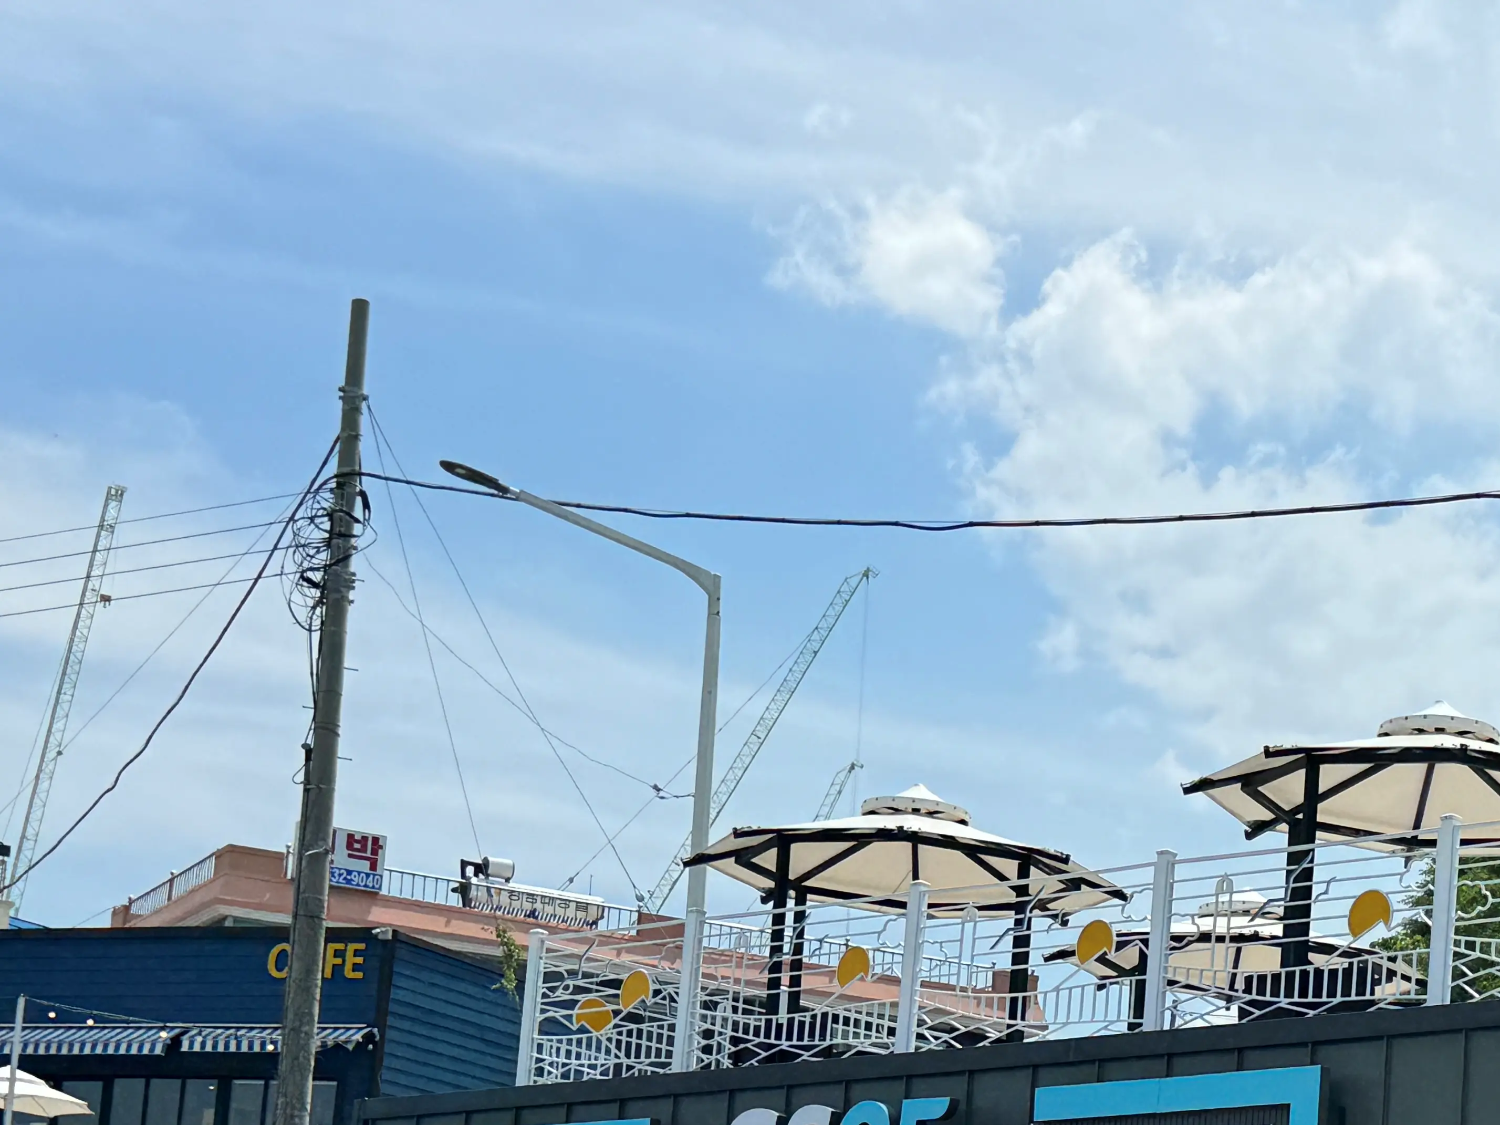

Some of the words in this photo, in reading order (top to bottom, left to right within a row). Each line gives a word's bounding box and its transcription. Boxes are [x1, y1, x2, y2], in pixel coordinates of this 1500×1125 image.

[330, 829, 384, 872] 박
[330, 868, 382, 889] 32-9040
[267, 943, 366, 979] CFE
